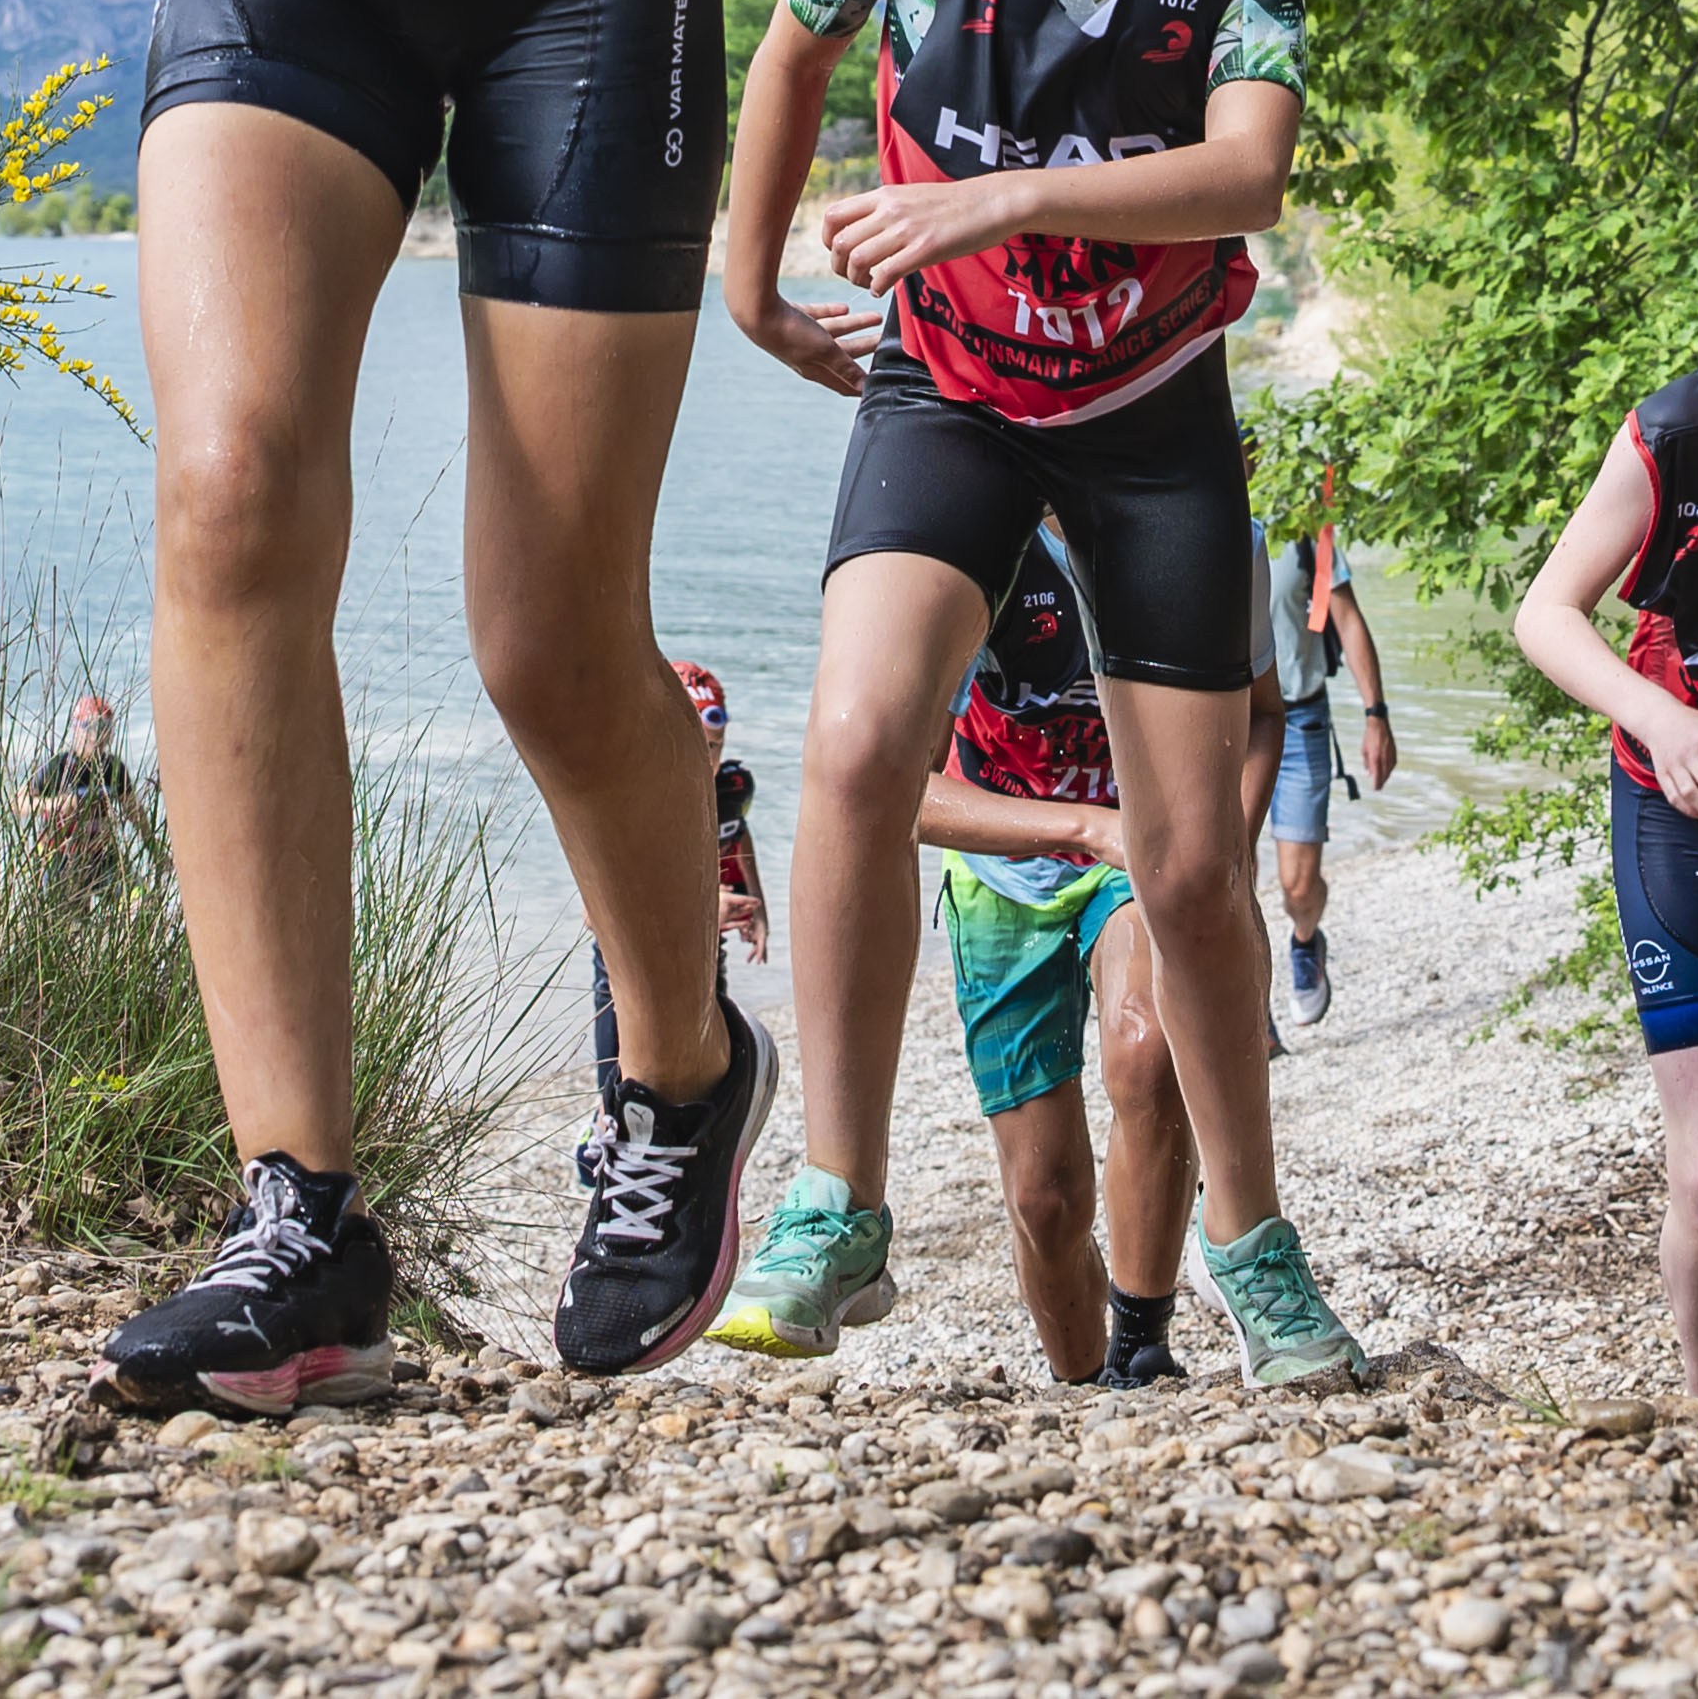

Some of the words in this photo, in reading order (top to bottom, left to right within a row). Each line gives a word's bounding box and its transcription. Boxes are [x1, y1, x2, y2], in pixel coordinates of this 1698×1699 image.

[669, 67, 682, 120] VAR
[1003, 241, 1137, 299] MAN
[1007, 276, 1144, 349] 1012
[1023, 591, 1056, 608] 2106
